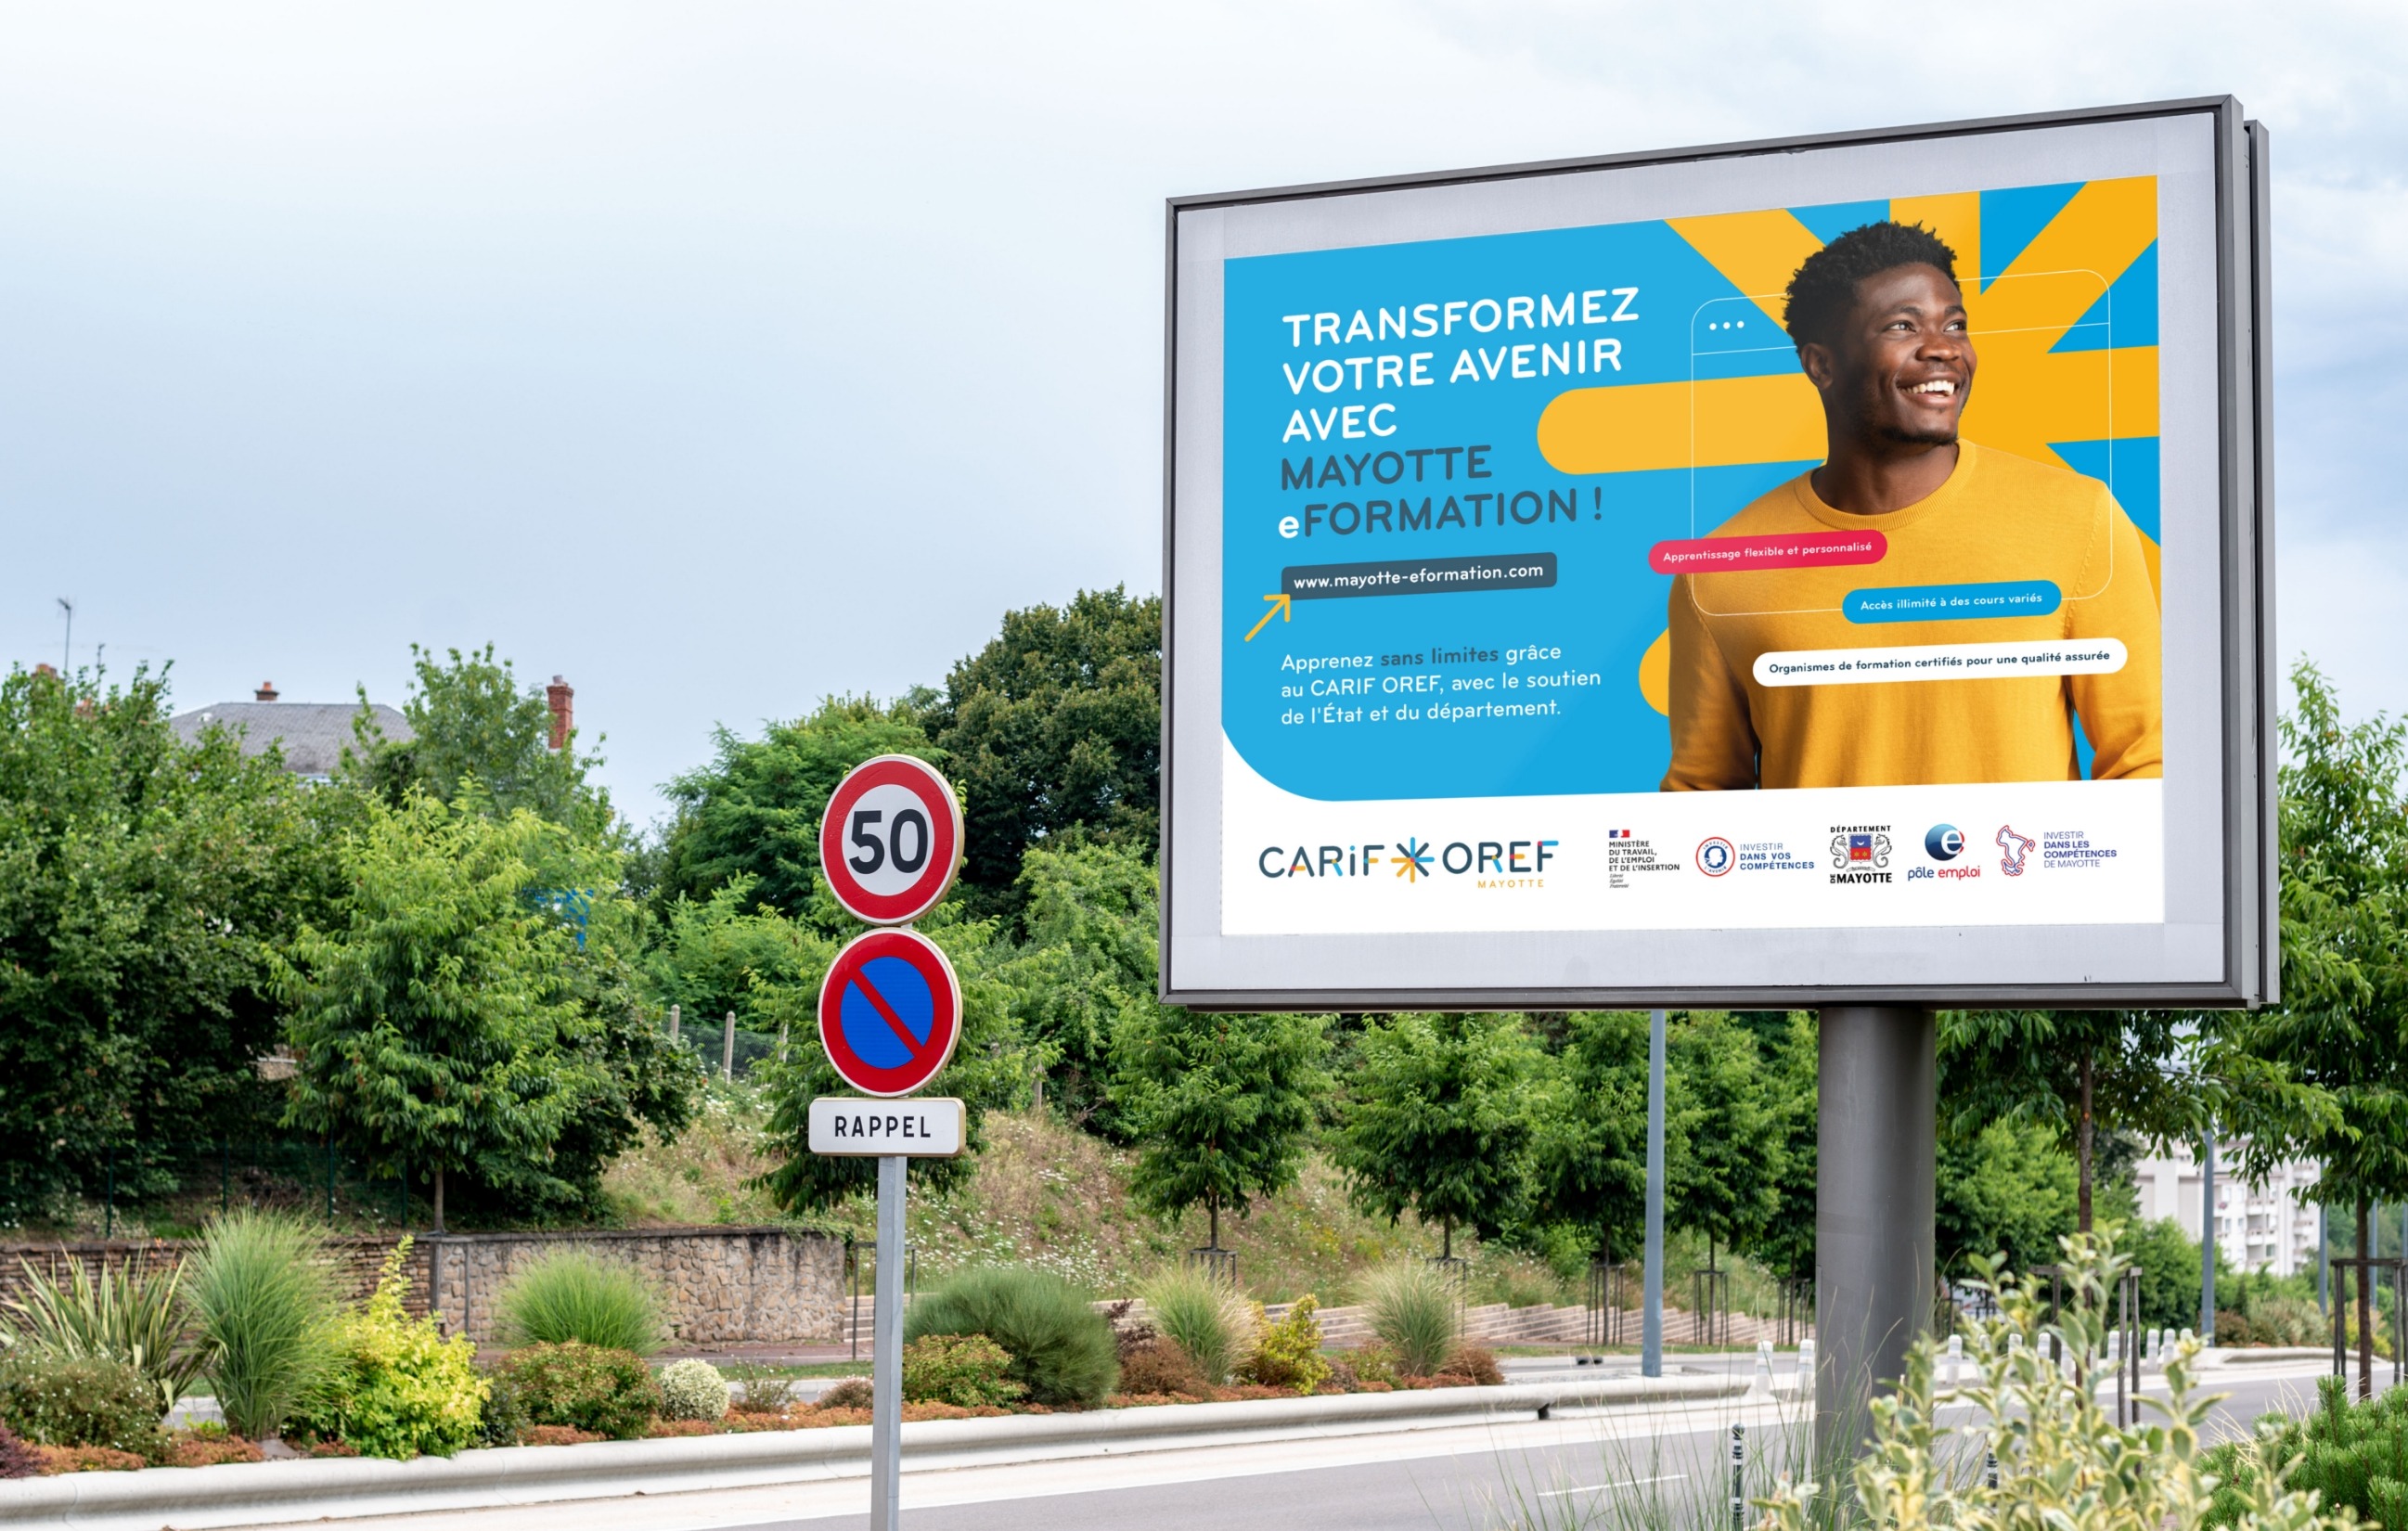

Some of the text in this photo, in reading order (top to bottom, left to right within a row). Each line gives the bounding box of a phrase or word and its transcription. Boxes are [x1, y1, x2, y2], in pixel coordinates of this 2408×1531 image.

[1282, 287, 1640, 348] TRANSFORMEZ
[1282, 338, 1622, 395] VOTRE AVENIR
[1282, 403, 1397, 444] AVEC
[1281, 444, 1492, 491] MAYOTTE
[1593, 486, 1603, 521] !
[1663, 541, 1873, 563] Apprentissage flexible et personnalisé
[1294, 564, 1544, 590] www.mayotte-eformation.com
[1861, 593, 2042, 611] Accès illimité à des cours variés
[1281, 644, 1562, 675] Apprenez sans limites grâce
[1769, 650, 2110, 675] Organismes de formation certifiés pour une qualité assurée
[1281, 669, 1602, 698] au CARIF OREF, avec le soutien
[1281, 698, 1562, 725] de l'État et du département.
[1830, 824, 1891, 833] DÉPARTEMENT
[2043, 830, 2084, 840] INVESTIR
[848, 807, 929, 876] 50
[1609, 840, 1650, 848] MINISTÈRE
[1740, 843, 1783, 851] INVESTIR
[2043, 840, 2090, 849] DANS LES
[1442, 840, 1560, 875] OREF
[1621, 856, 1655, 864] L'EMPLOI
[1622, 848, 1657, 856] TRAVAIL,
[1740, 852, 1792, 861] DANS VOS
[2043, 848, 2118, 858] COMPÉTENCES
[1740, 860, 1815, 870] COMPÉTENCES
[2043, 858, 2101, 868] DE MAYOTTE
[1829, 872, 1893, 884] DE MAYOTTE
[1908, 865, 1980, 881] pôle emploi
[1477, 879, 1545, 889] MAYOTTE
[834, 1114, 932, 1139] RAPPEL
